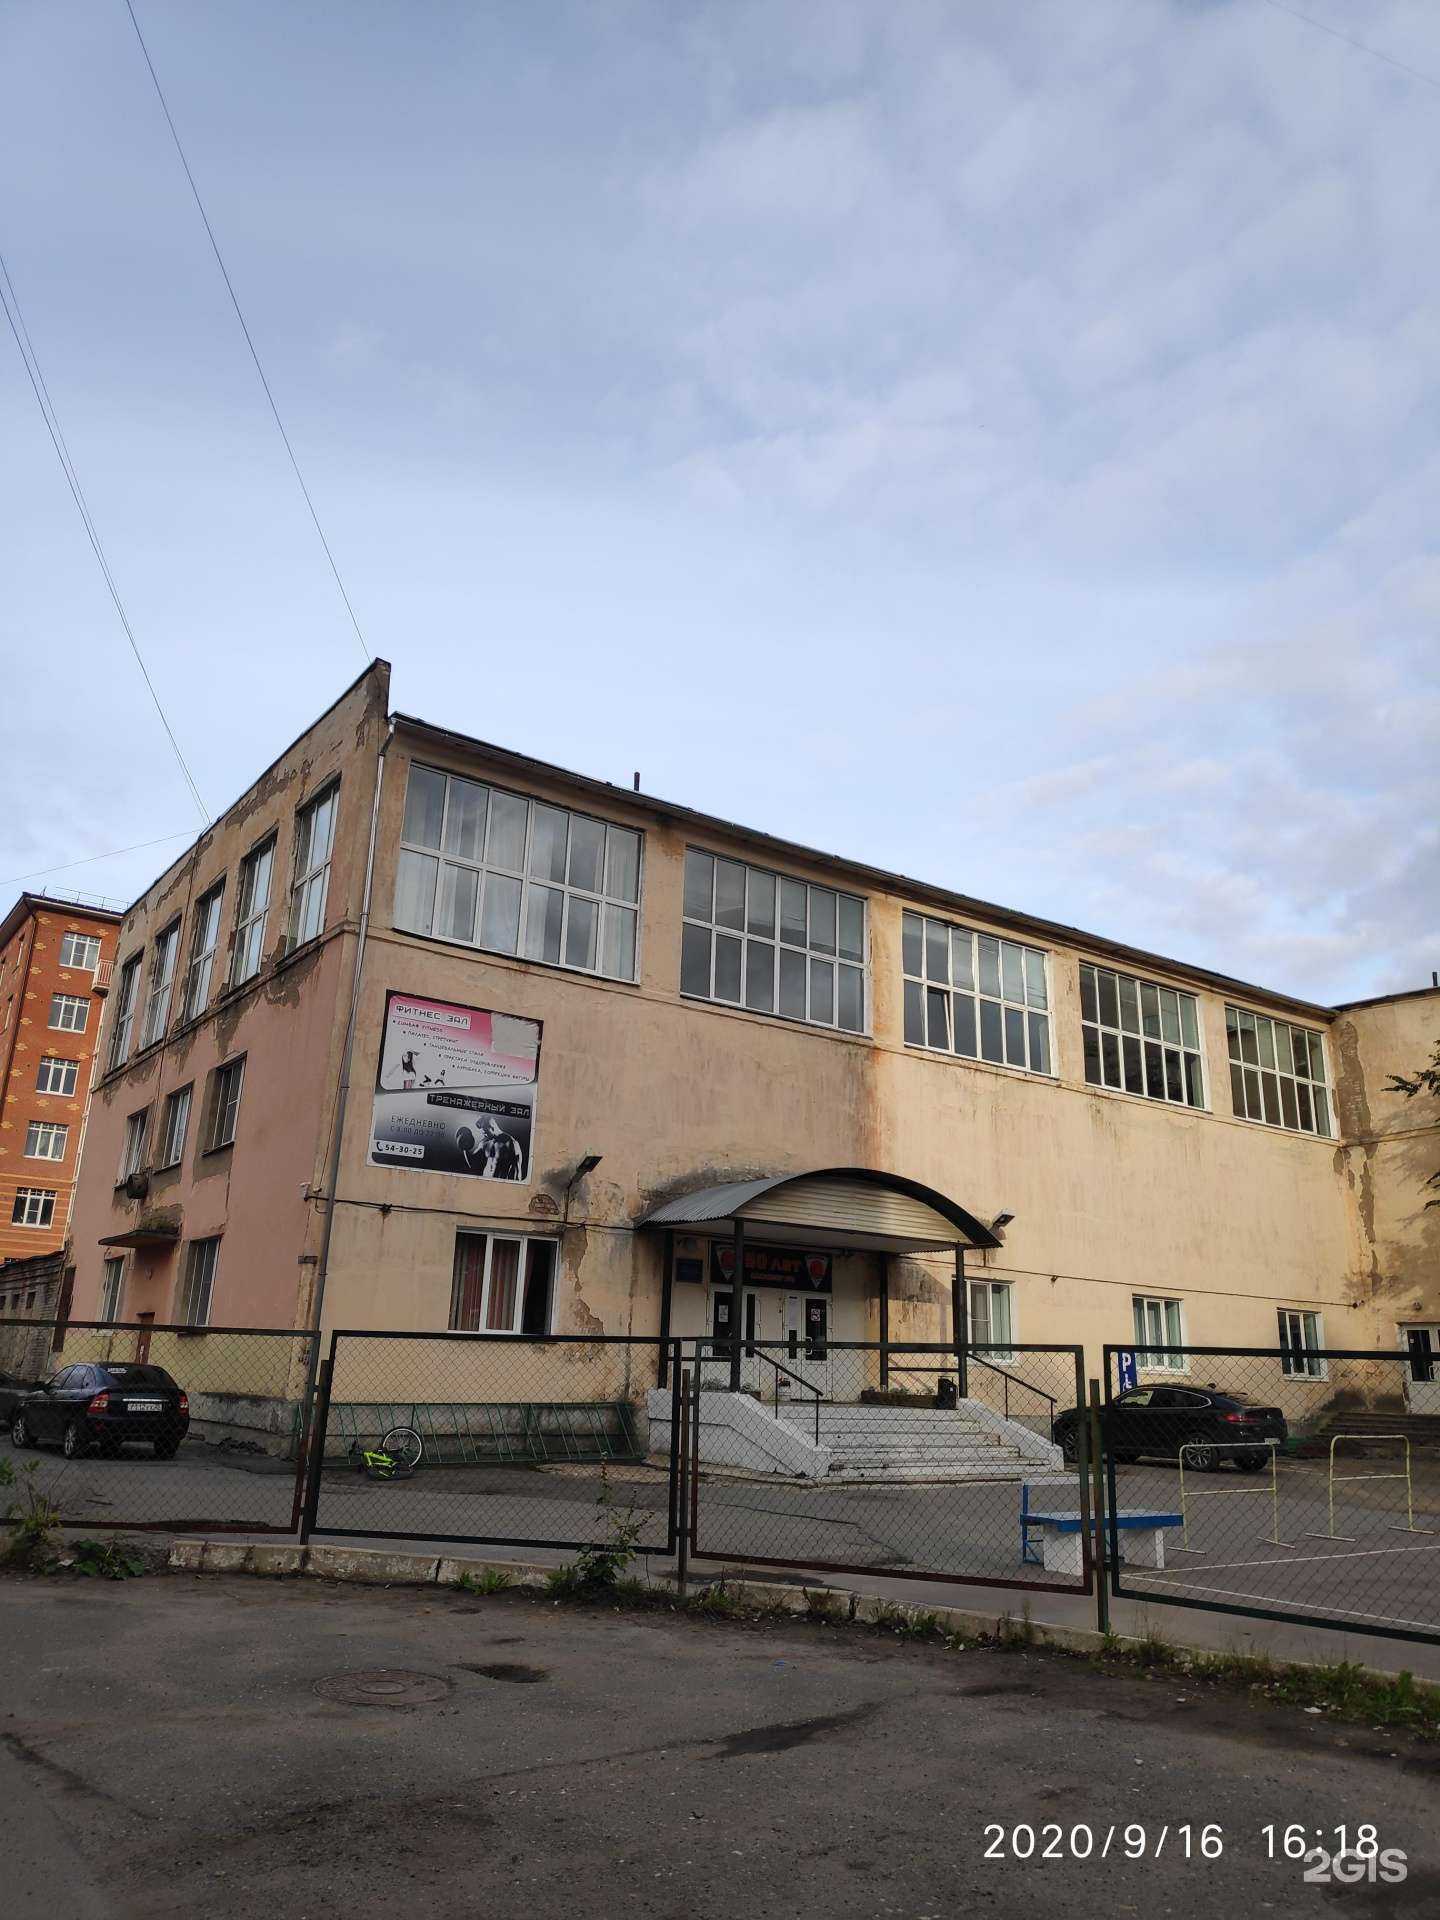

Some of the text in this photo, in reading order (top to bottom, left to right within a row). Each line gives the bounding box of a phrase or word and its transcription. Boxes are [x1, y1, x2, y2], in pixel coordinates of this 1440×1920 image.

[395, 1005, 469, 1025] ФИТНЕС ЗАЛ
[429, 1094, 530, 1117] ТРЕНАЖЕРНЫЙ ЗАЛ
[391, 1115, 446, 1130] ЕЖЕДНЕВНО
[413, 1128, 423, 1136] ДО
[385, 1143, 423, 1155] 54-30-25
[1122, 1352, 1131, 1371] P
